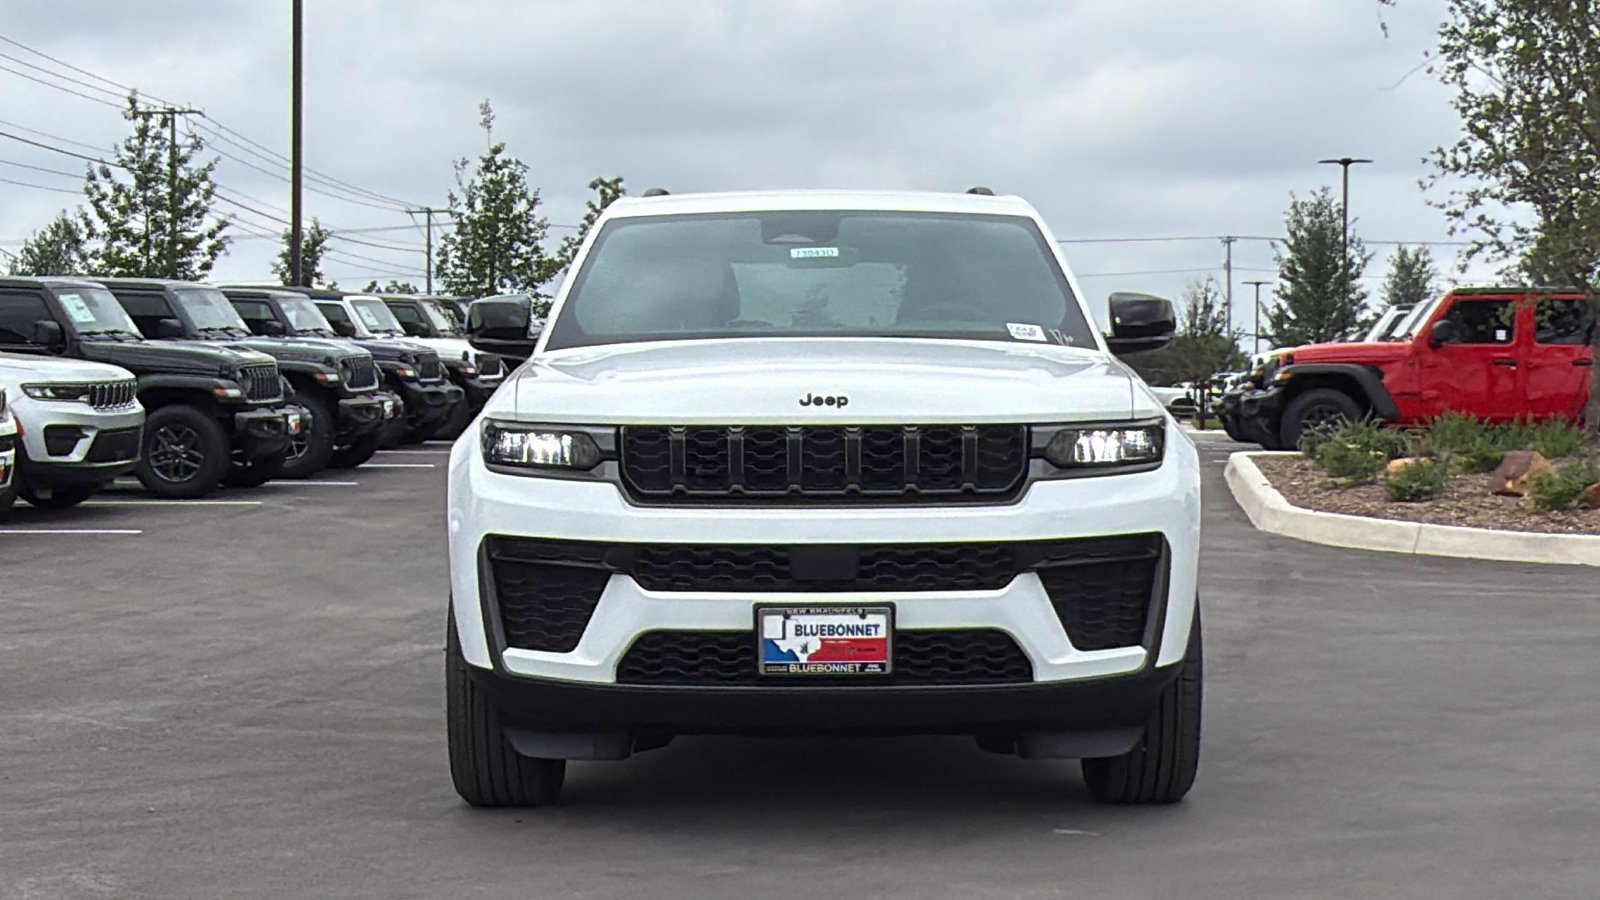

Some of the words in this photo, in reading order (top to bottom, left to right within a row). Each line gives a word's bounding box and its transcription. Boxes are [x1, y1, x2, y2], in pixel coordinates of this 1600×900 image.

[799, 392, 848, 408] Jeep
[794, 624, 881, 637] BLUEBONNET
[789, 664, 861, 673] BLUEBONNET
